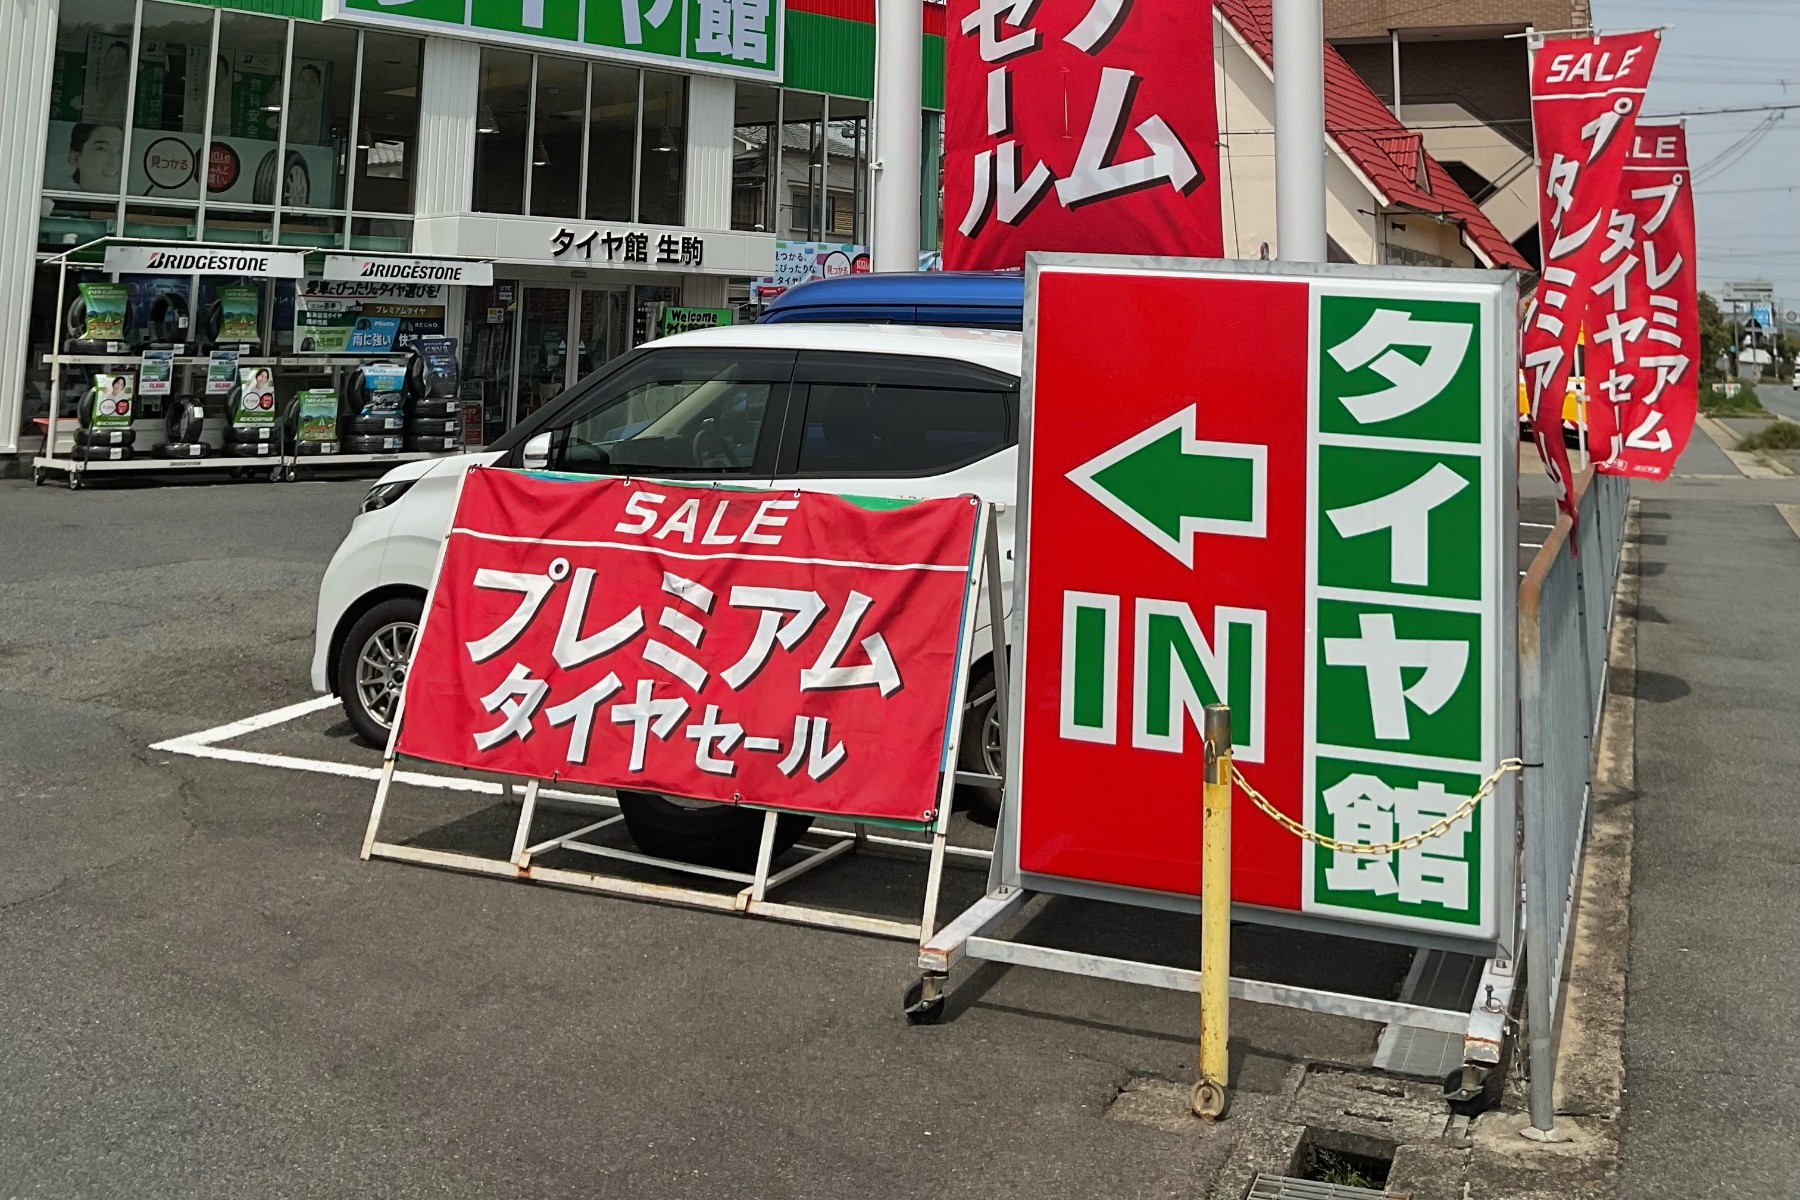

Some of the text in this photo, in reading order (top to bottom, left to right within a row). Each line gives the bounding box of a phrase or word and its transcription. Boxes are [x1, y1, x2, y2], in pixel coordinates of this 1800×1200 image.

[1545, 45, 1643, 84] SALE
[1627, 136, 1677, 158] LE
[150, 155, 189, 170] 見つかる
[147, 252, 269, 272] BRIDGESTONE
[551, 228, 704, 266] タイヤ館 生駒
[360, 261, 463, 281] BRIDGESTONE
[827, 265, 848, 275] 見つかる
[375, 305, 427, 316] プレミアムタイヤ
[671, 310, 718, 323] Welcome
[1625, 173, 1690, 453] プレミアム
[352, 333, 391, 347] 雨に強い
[614, 490, 800, 546] SALE
[1323, 307, 1474, 911] タイヤ館
[464, 557, 904, 699] プレミアム
[1060, 589, 1266, 763] IN
[472, 661, 848, 782] タイヤセール
